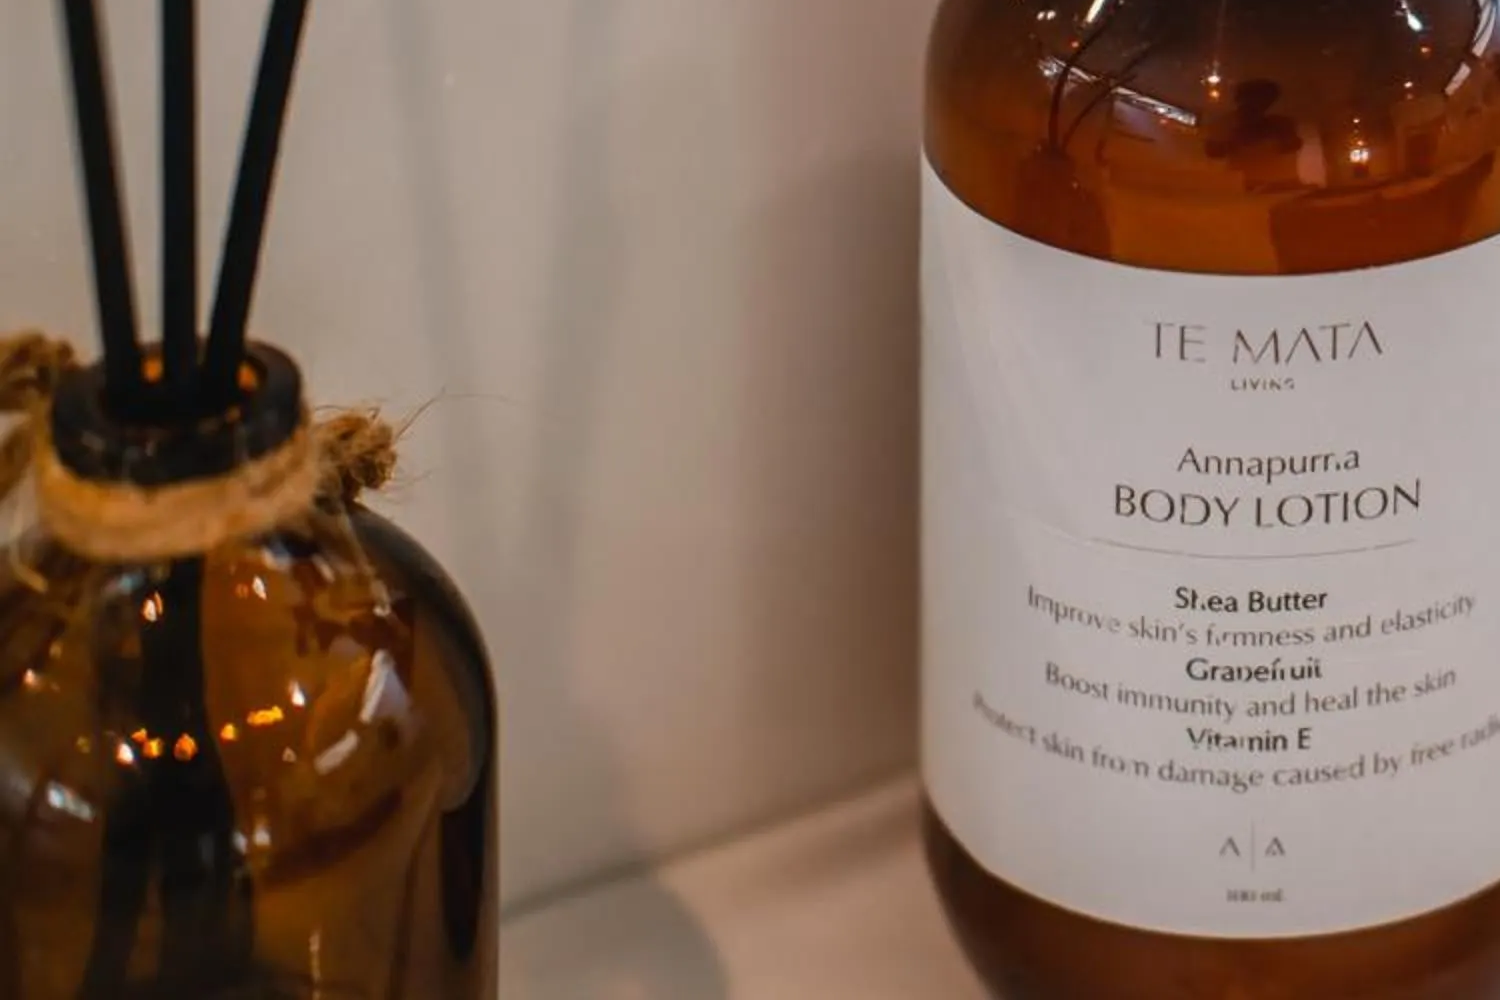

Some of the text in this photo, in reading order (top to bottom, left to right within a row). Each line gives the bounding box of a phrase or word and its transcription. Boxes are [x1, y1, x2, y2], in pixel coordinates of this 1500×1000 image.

[1144, 320, 1384, 365] TE MATA
[1230, 377, 1296, 392] LIVING
[1177, 446, 1361, 485] Annapurna
[1114, 478, 1422, 529] BODY LOTION
[1027, 584, 1122, 634] Improve
[1206, 622, 1316, 648] firmness
[1323, 615, 1372, 644] and
[1381, 593, 1477, 636] elasticity
[1175, 586, 1328, 614] Shea Butter
[1186, 656, 1324, 683] Grapefruit
[1045, 660, 1457, 724] Boost immunity and heal the skin
[1186, 727, 1313, 753] Vitamin E
[1042, 730, 1086, 763] skin
[1091, 744, 1150, 780] from
[1158, 759, 1265, 794] damage
[1272, 754, 1366, 788] caused
[1373, 751, 1403, 779] by
[1410, 737, 1456, 768] free
